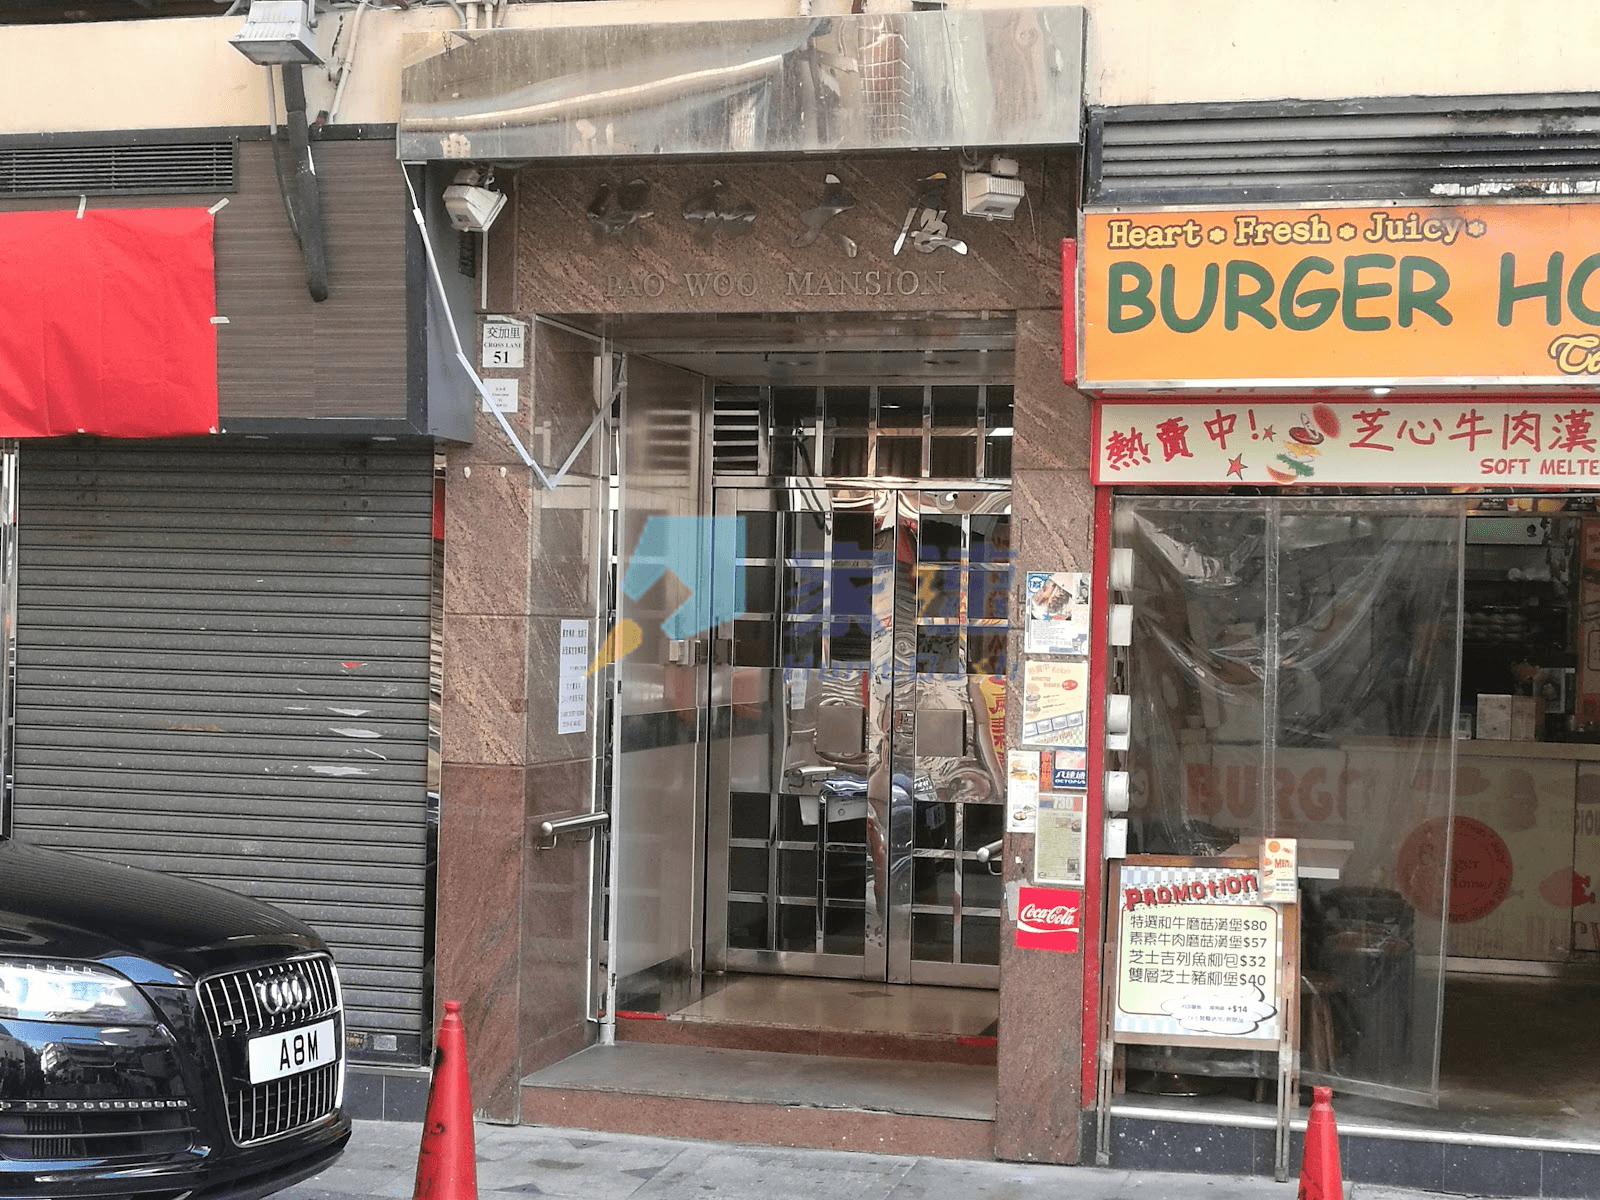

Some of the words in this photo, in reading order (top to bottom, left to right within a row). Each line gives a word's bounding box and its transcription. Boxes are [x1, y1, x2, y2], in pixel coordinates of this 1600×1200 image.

[1108, 218, 1201, 249] Heart
[1234, 215, 1331, 247] Fresh
[1364, 212, 1464, 246] Juicy
[604, 272, 665, 297] PAO
[684, 270, 758, 297] WOO
[785, 269, 948, 297] MANSION
[1107, 253, 1454, 334] BURGER
[486, 326, 521, 339] 交加里
[493, 351, 509, 364] 51
[1479, 458, 1531, 475] SOFT
[1539, 458, 1600, 476] MELTE
[279, 1030, 319, 1071] A8M
